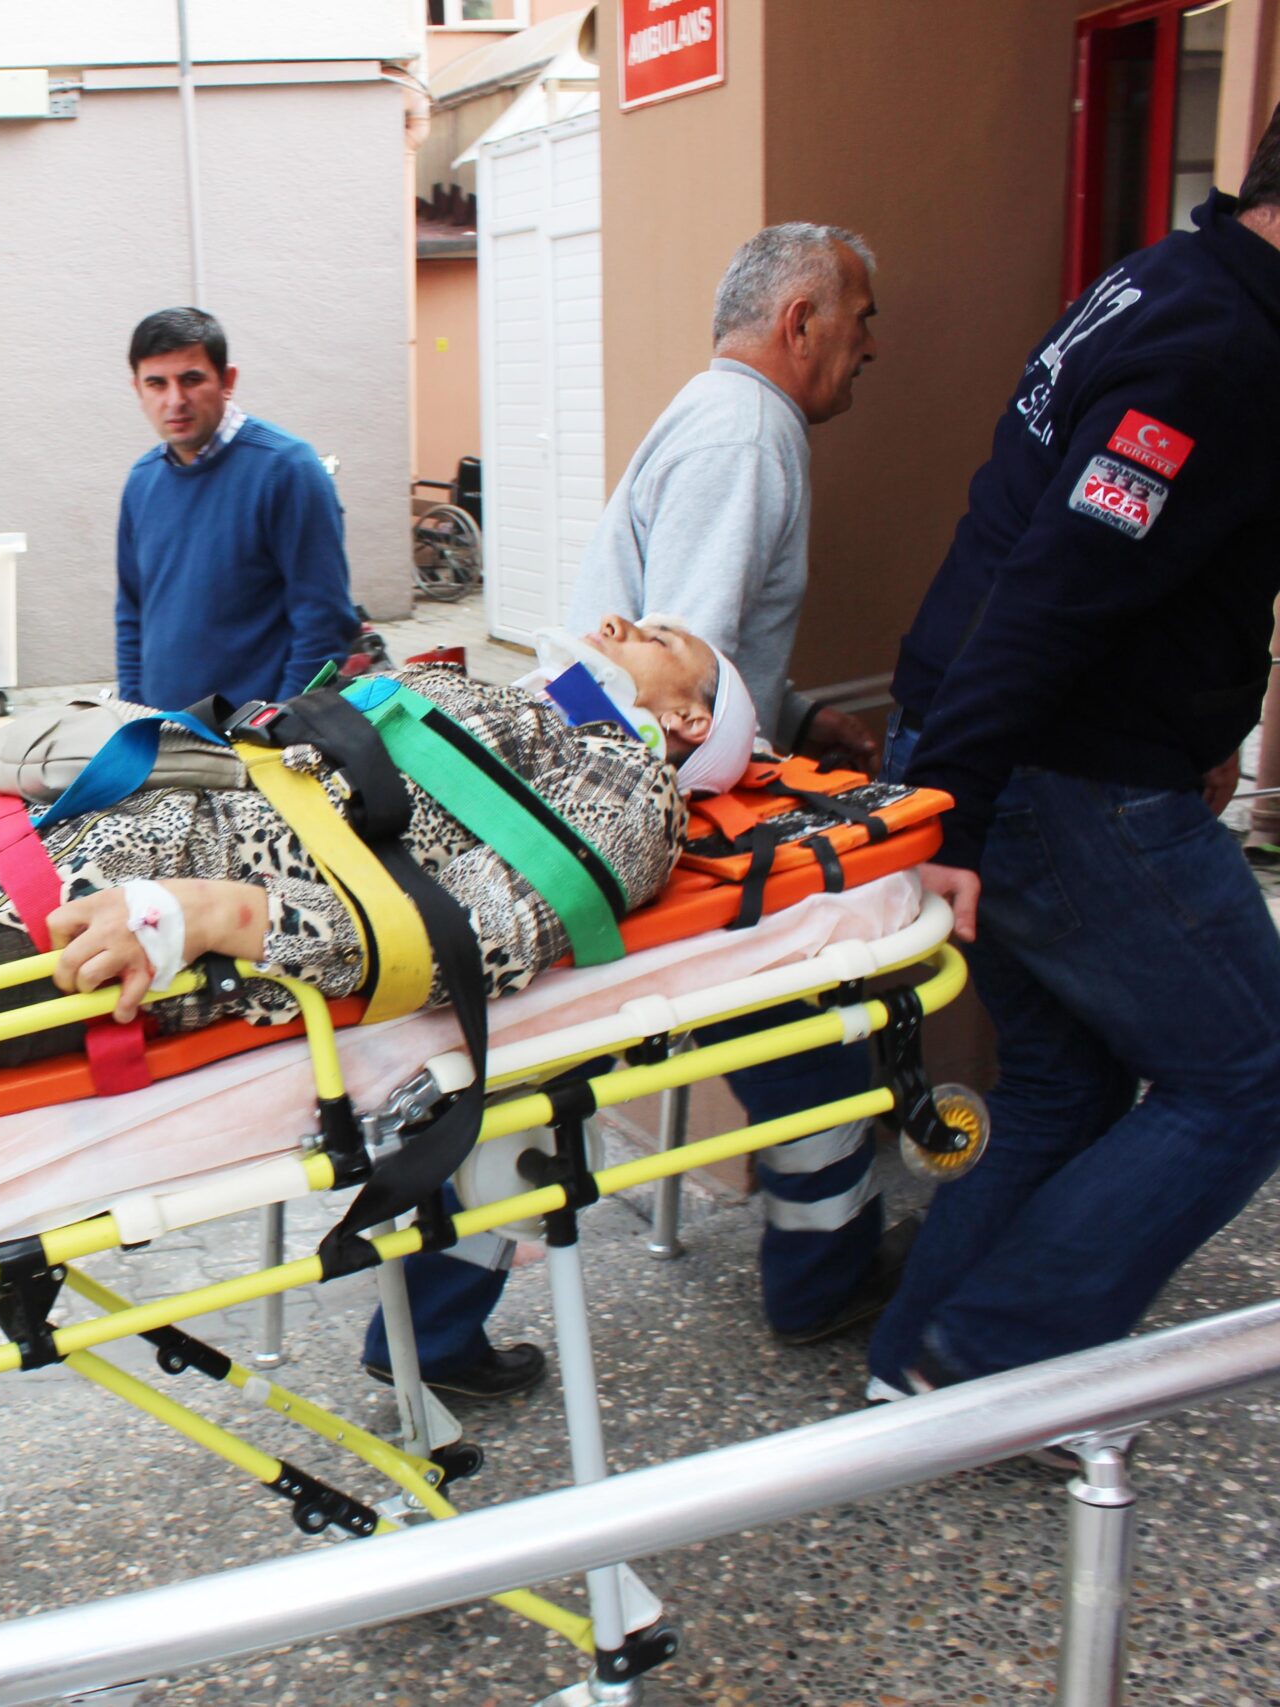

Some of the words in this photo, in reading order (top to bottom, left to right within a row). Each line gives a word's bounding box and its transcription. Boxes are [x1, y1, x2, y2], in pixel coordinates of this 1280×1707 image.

[627, 6, 713, 66] AMBULANS
[1087, 484, 1142, 523] ACİL
[1104, 470, 1151, 502] 112
